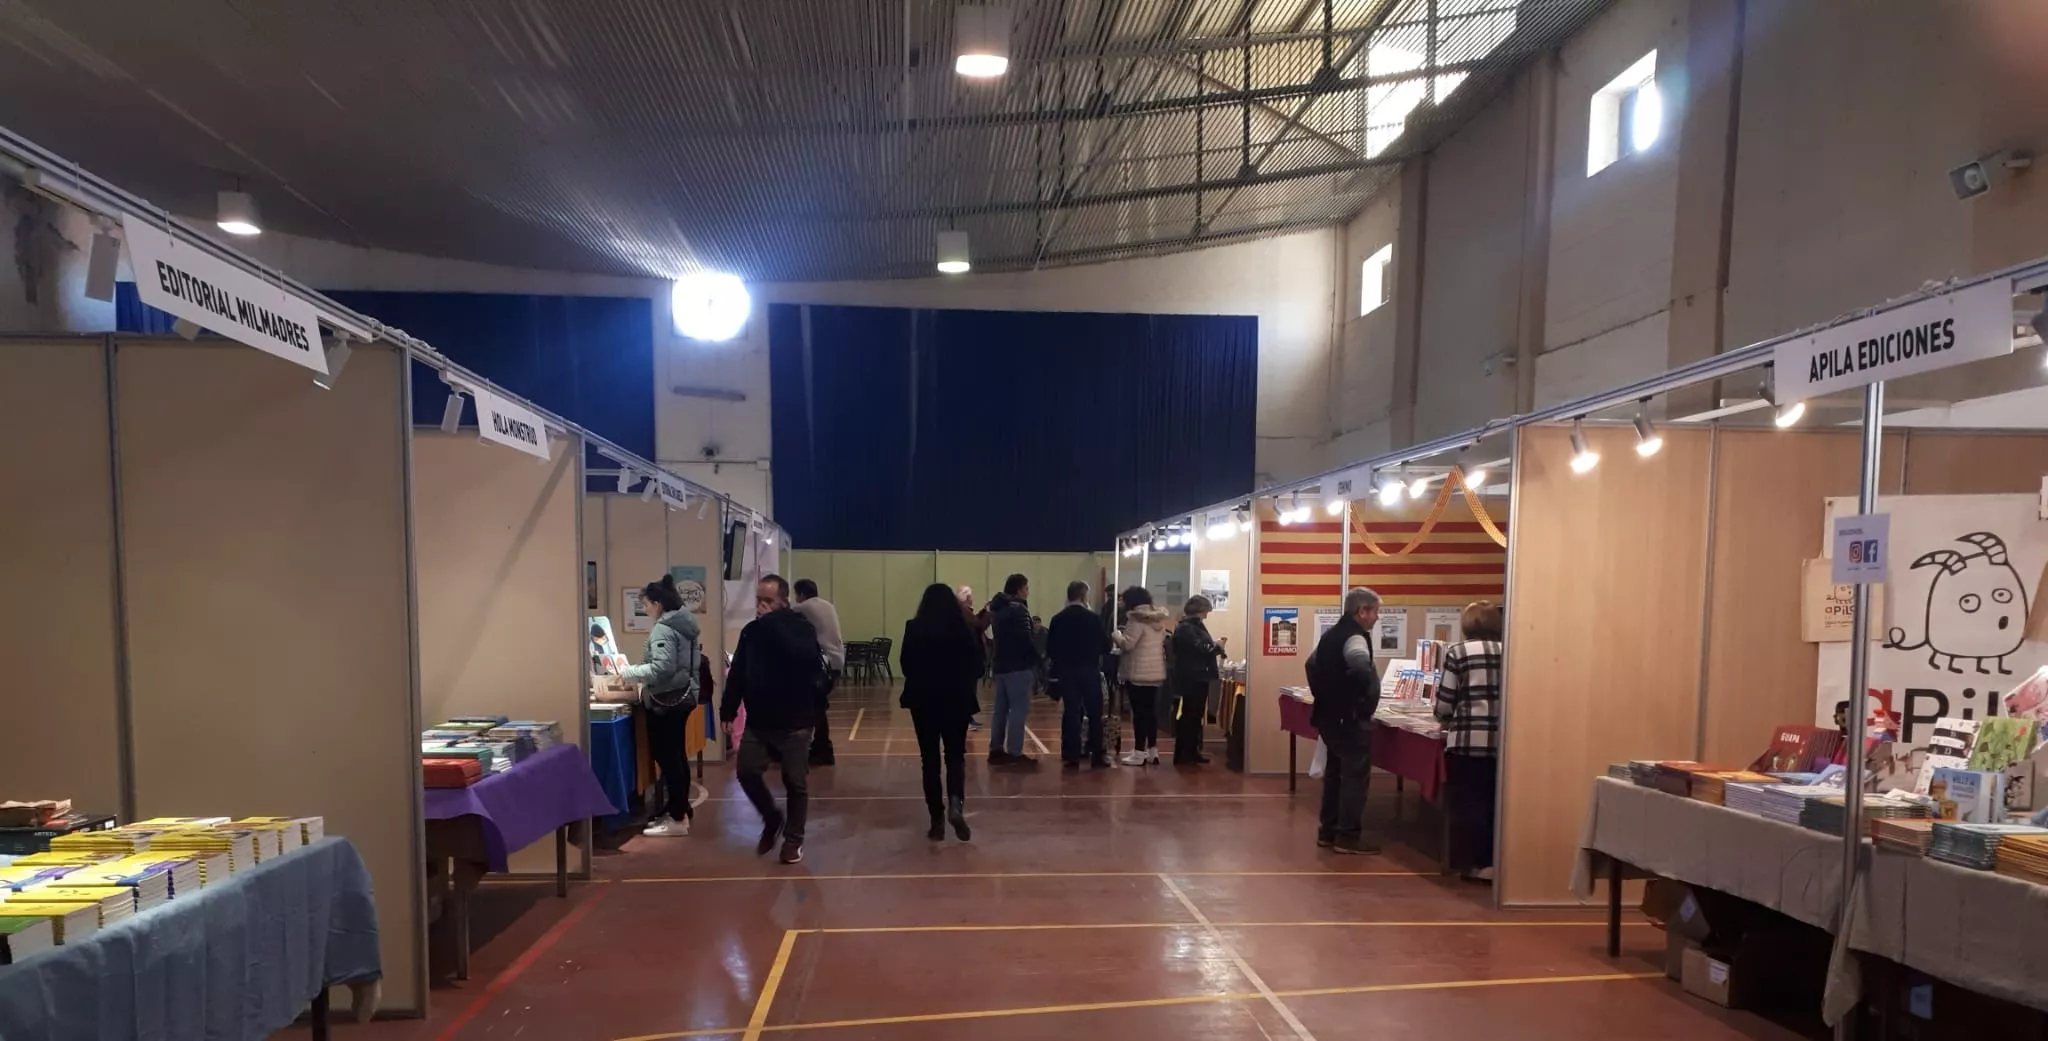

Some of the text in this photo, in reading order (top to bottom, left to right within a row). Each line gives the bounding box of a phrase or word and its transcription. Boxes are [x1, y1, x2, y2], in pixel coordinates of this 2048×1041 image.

[156, 259, 310, 352] EDITORIAL MILMADRES
[1809, 318, 1956, 384] APILA EDICIONES
[491, 410, 538, 447] HOLA MONSTRUO
